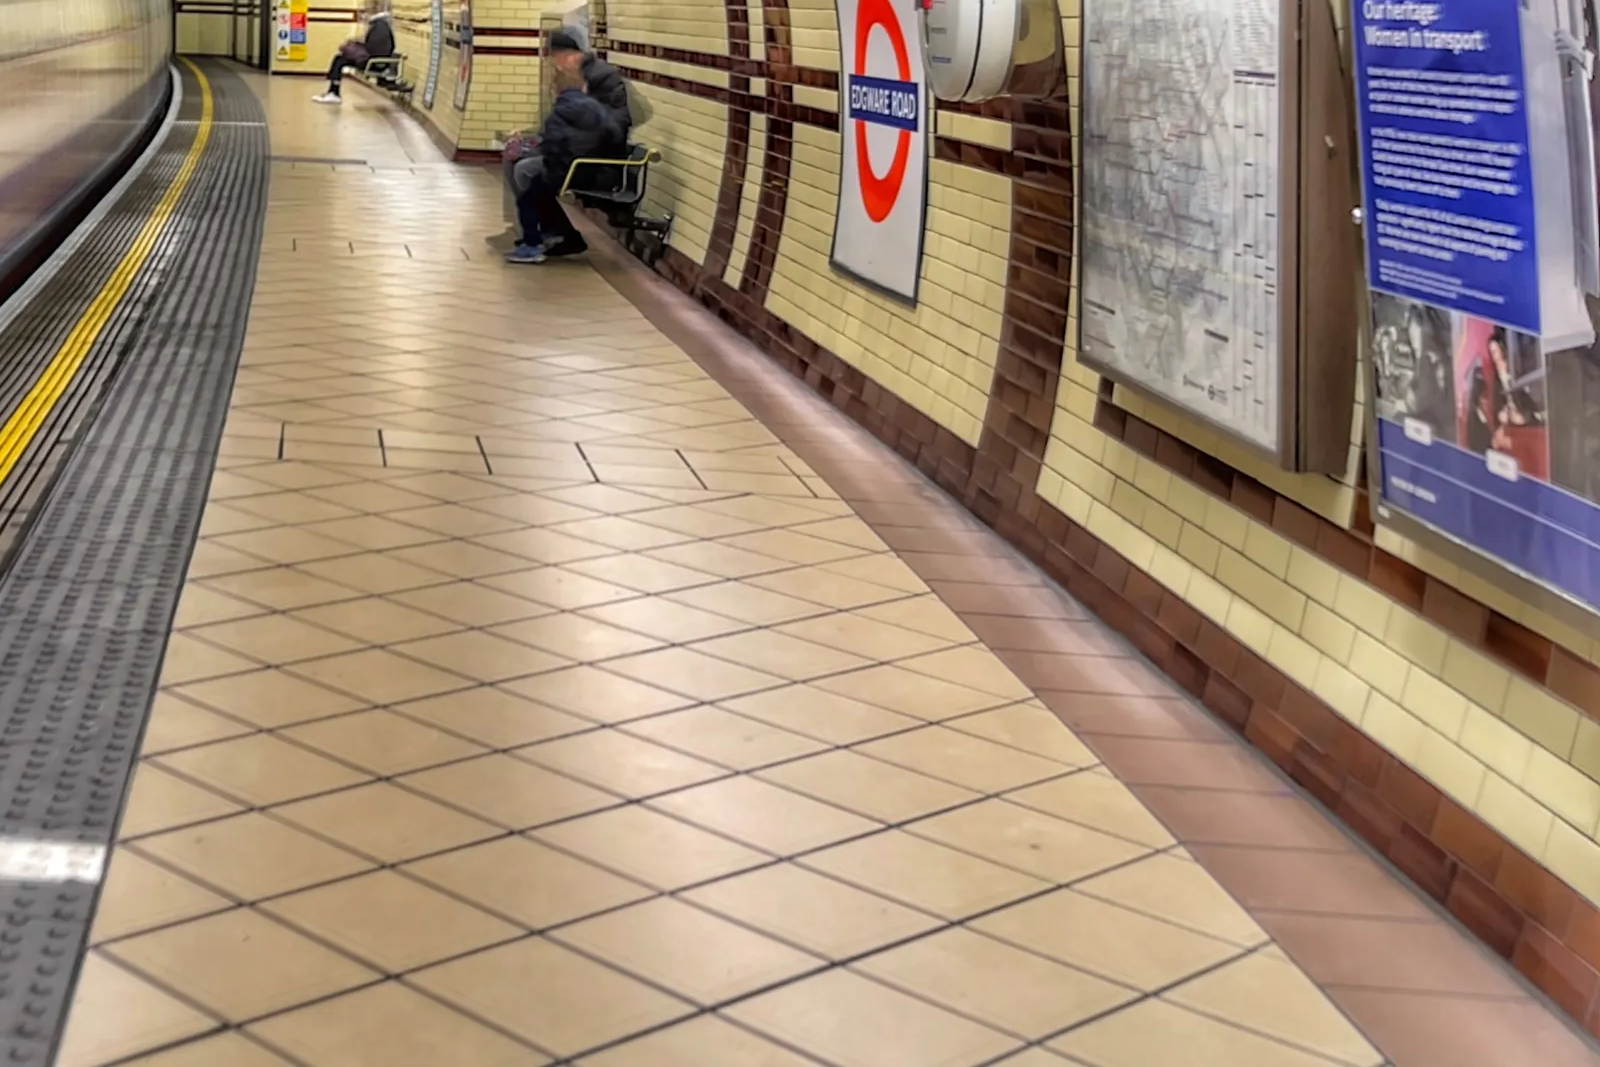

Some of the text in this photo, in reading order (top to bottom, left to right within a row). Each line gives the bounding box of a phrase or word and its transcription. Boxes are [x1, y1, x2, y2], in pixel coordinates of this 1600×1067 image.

[1362, 0, 1384, 21] Our
[1363, 25, 1408, 48] Women
[1408, 27, 1423, 49] in
[851, 85, 916, 120] EDGWARE ROAD
